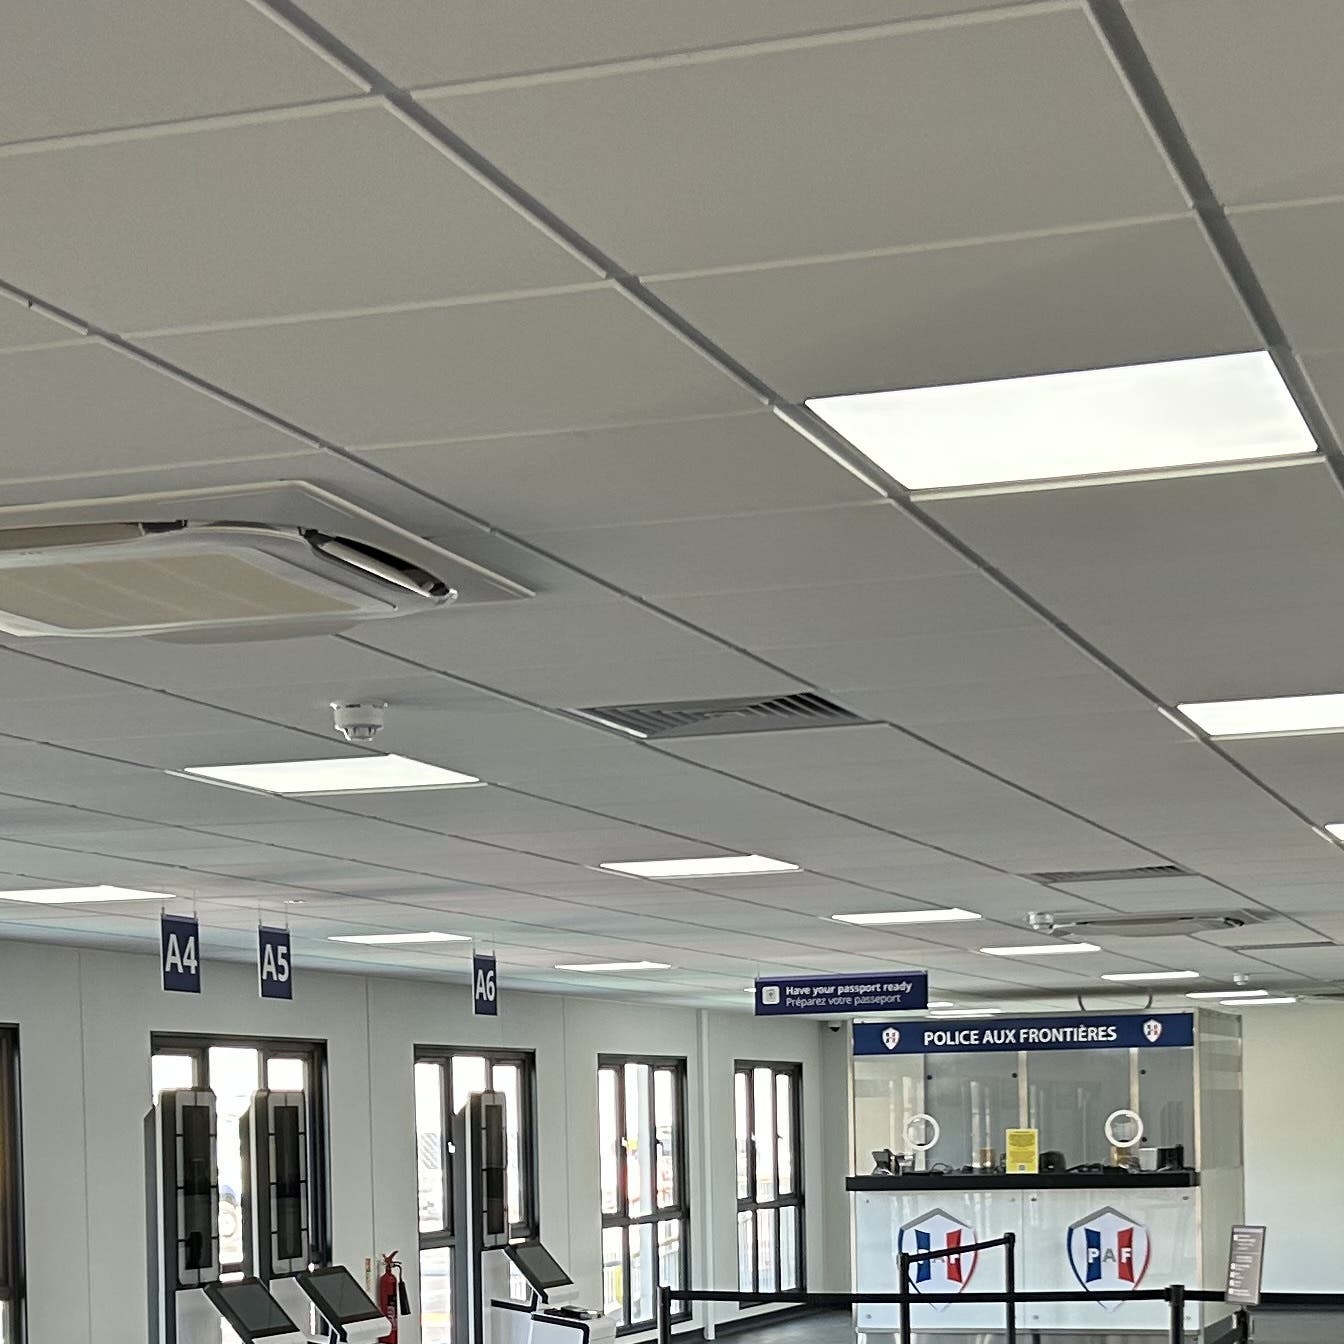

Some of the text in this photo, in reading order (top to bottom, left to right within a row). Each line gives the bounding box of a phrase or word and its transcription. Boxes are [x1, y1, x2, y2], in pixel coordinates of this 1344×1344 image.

[165, 933, 198, 974] A4
[262, 944, 289, 982] A5
[476, 969, 495, 1001] A6
[786, 981, 912, 997] Have your passport ready
[786, 994, 901, 1009] Préparez votre passeport
[924, 1024, 1117, 1046] POLICE AUX FRONTIÈRES
[1087, 1247, 1132, 1264] PAF
